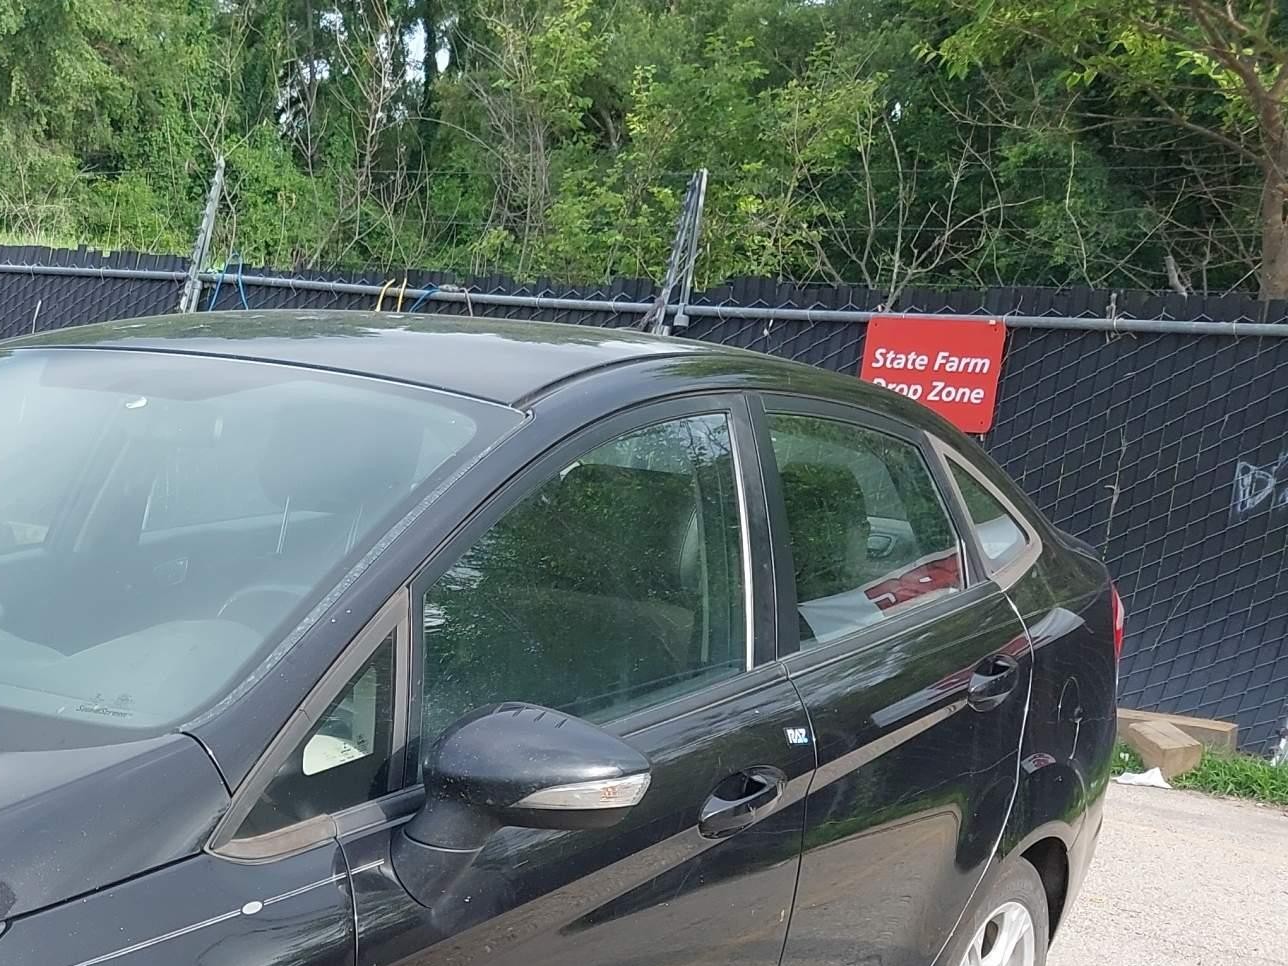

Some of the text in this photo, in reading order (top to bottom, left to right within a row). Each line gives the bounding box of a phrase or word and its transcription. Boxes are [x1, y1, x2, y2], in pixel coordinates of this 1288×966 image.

[871, 348, 990, 374] State Farm
[926, 381, 985, 404] Zone
